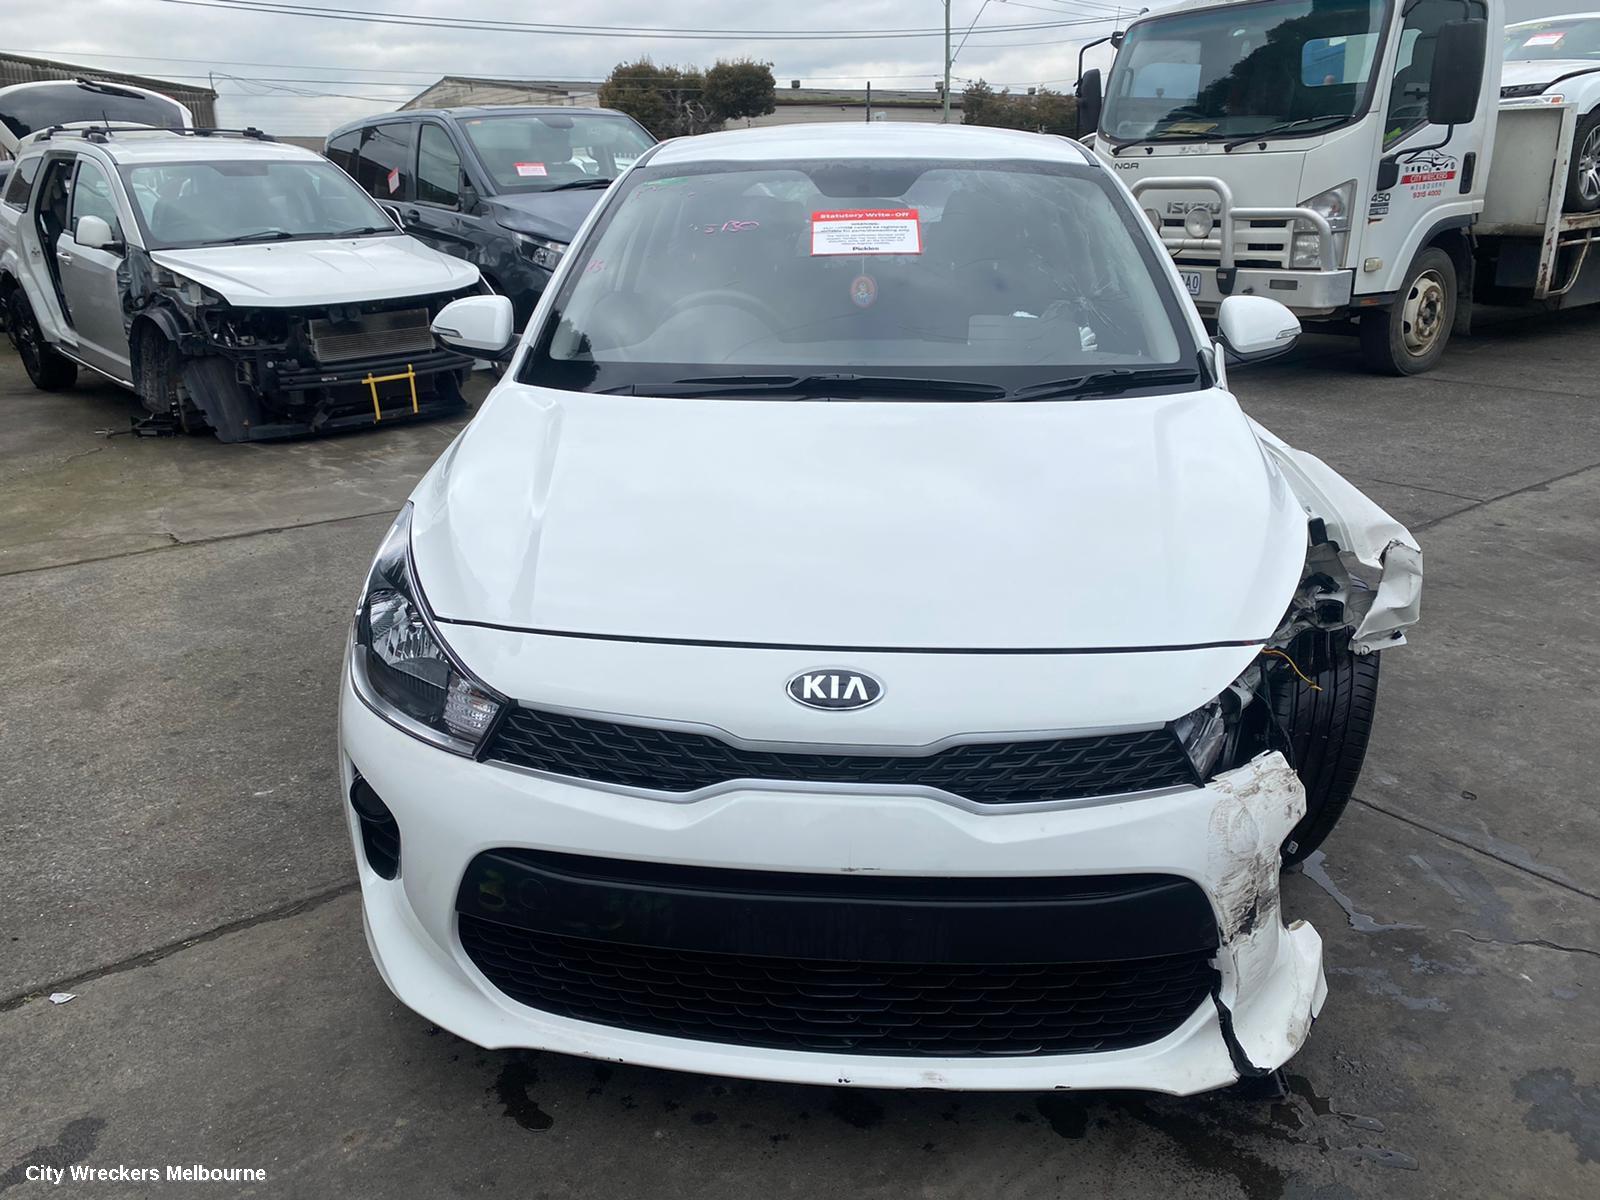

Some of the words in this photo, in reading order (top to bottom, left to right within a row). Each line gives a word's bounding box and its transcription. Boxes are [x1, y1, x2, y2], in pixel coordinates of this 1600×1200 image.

[1114, 162, 1139, 170] NQR
[1410, 174, 1423, 182] CITY
[1370, 193, 1391, 202] 450
[803, 675, 869, 701] KIA
